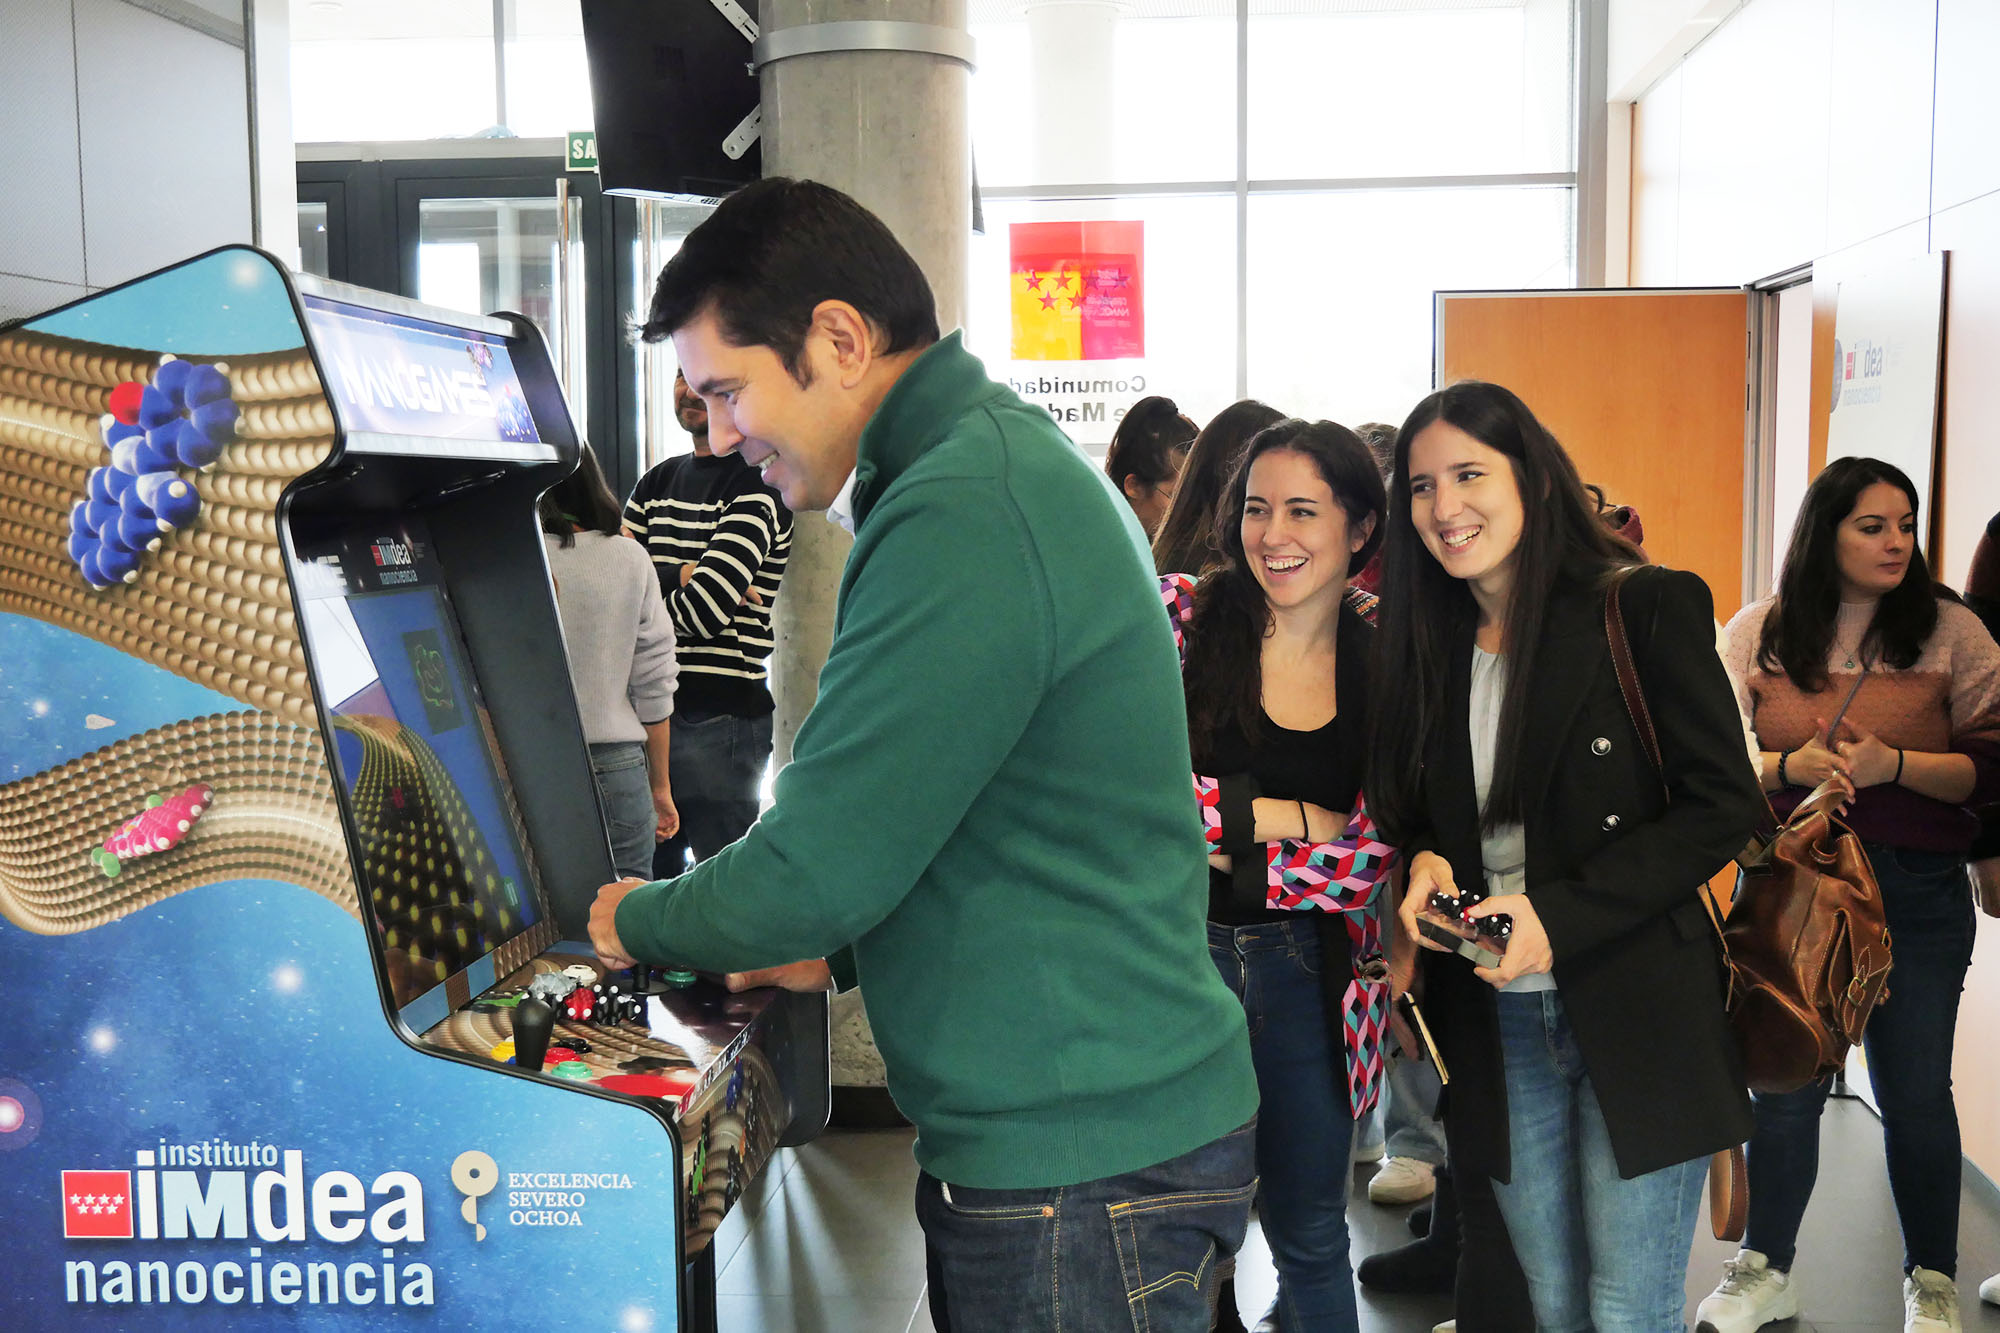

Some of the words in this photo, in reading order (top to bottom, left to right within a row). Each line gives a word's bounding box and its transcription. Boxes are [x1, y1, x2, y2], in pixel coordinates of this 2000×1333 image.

[572, 139, 597, 160] SA
[1853, 339, 1883, 380] idea
[333, 354, 498, 419] NANOGAMES
[379, 566, 418, 585] nanociencia
[159, 1138, 279, 1167] instituto
[508, 1172, 632, 1189] EXCELENCIA
[508, 1191, 586, 1208] SEVERO
[509, 1210, 583, 1227] OCHOA
[65, 1248, 434, 1306] nanociencia
